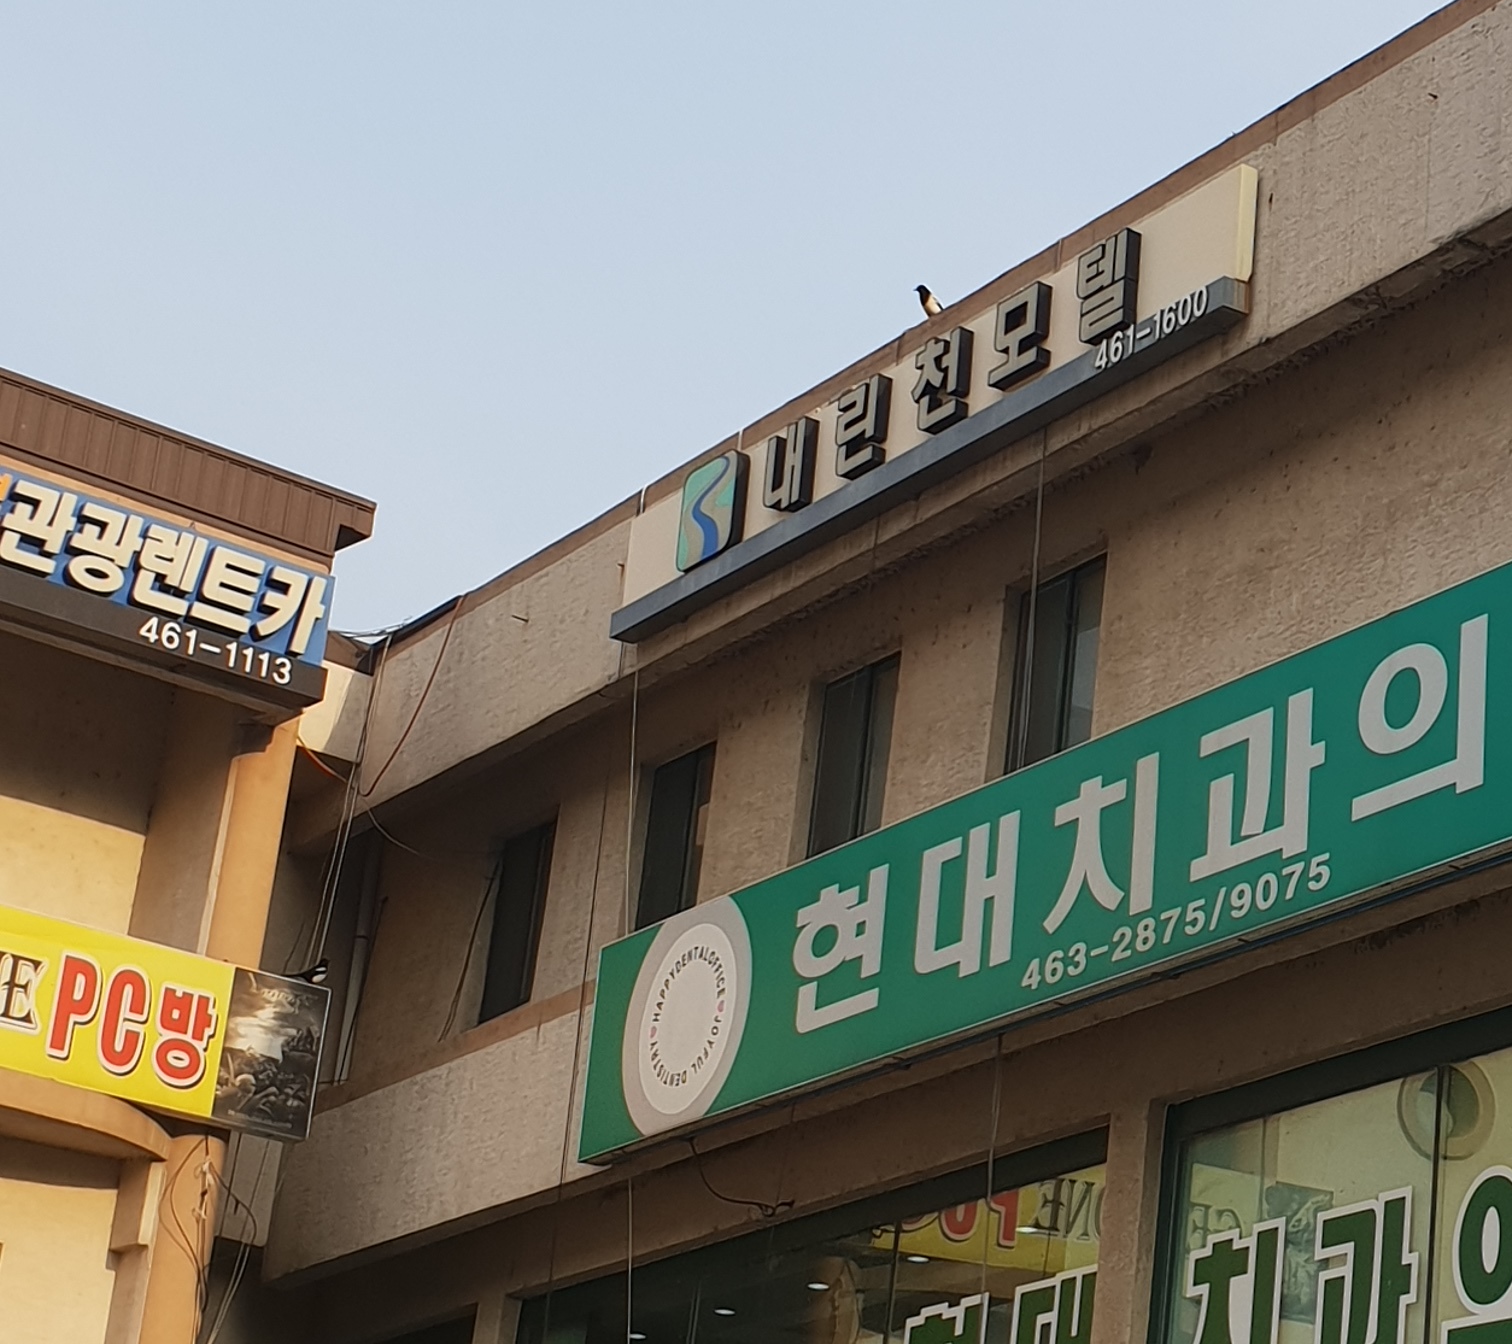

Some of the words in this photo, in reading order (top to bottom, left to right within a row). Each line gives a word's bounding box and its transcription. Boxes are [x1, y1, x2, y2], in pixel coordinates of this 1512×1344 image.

[763, 227, 1141, 513] 내린천모텔
[1094, 285, 1208, 371] 461-1600
[0, 478, 327, 656] 관광렌트카
[139, 616, 292, 685] 461-1113
[1020, 852, 1333, 991] 463-2875/9075
[47, 949, 218, 1089] PC방
